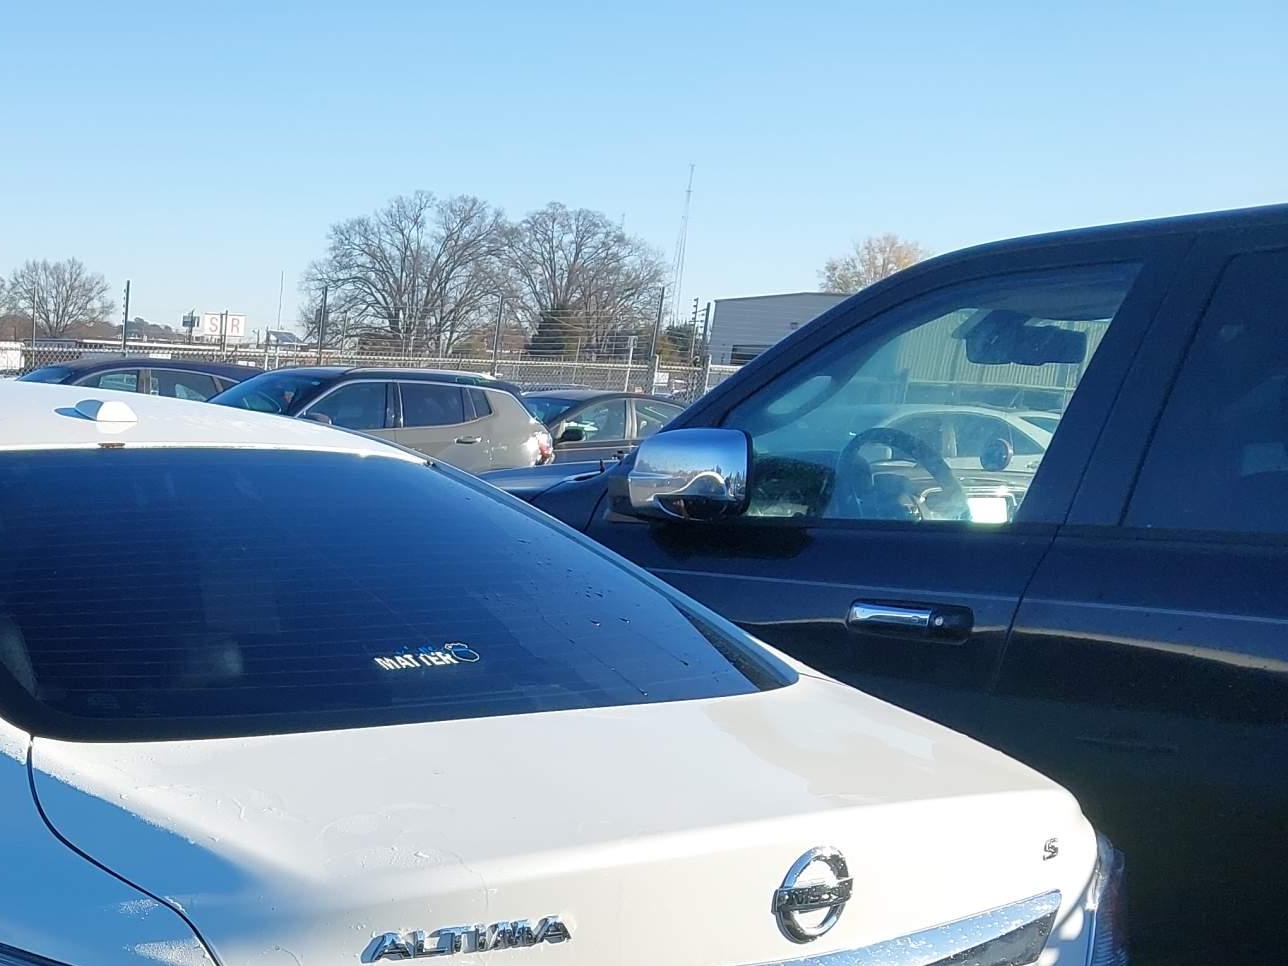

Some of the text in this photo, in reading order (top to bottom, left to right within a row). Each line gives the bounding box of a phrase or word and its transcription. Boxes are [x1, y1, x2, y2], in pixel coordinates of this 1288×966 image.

[209, 316, 219, 333] S
[230, 317, 241, 334] R
[1042, 836, 1059, 862] S
[360, 915, 572, 963] ALTIMA
